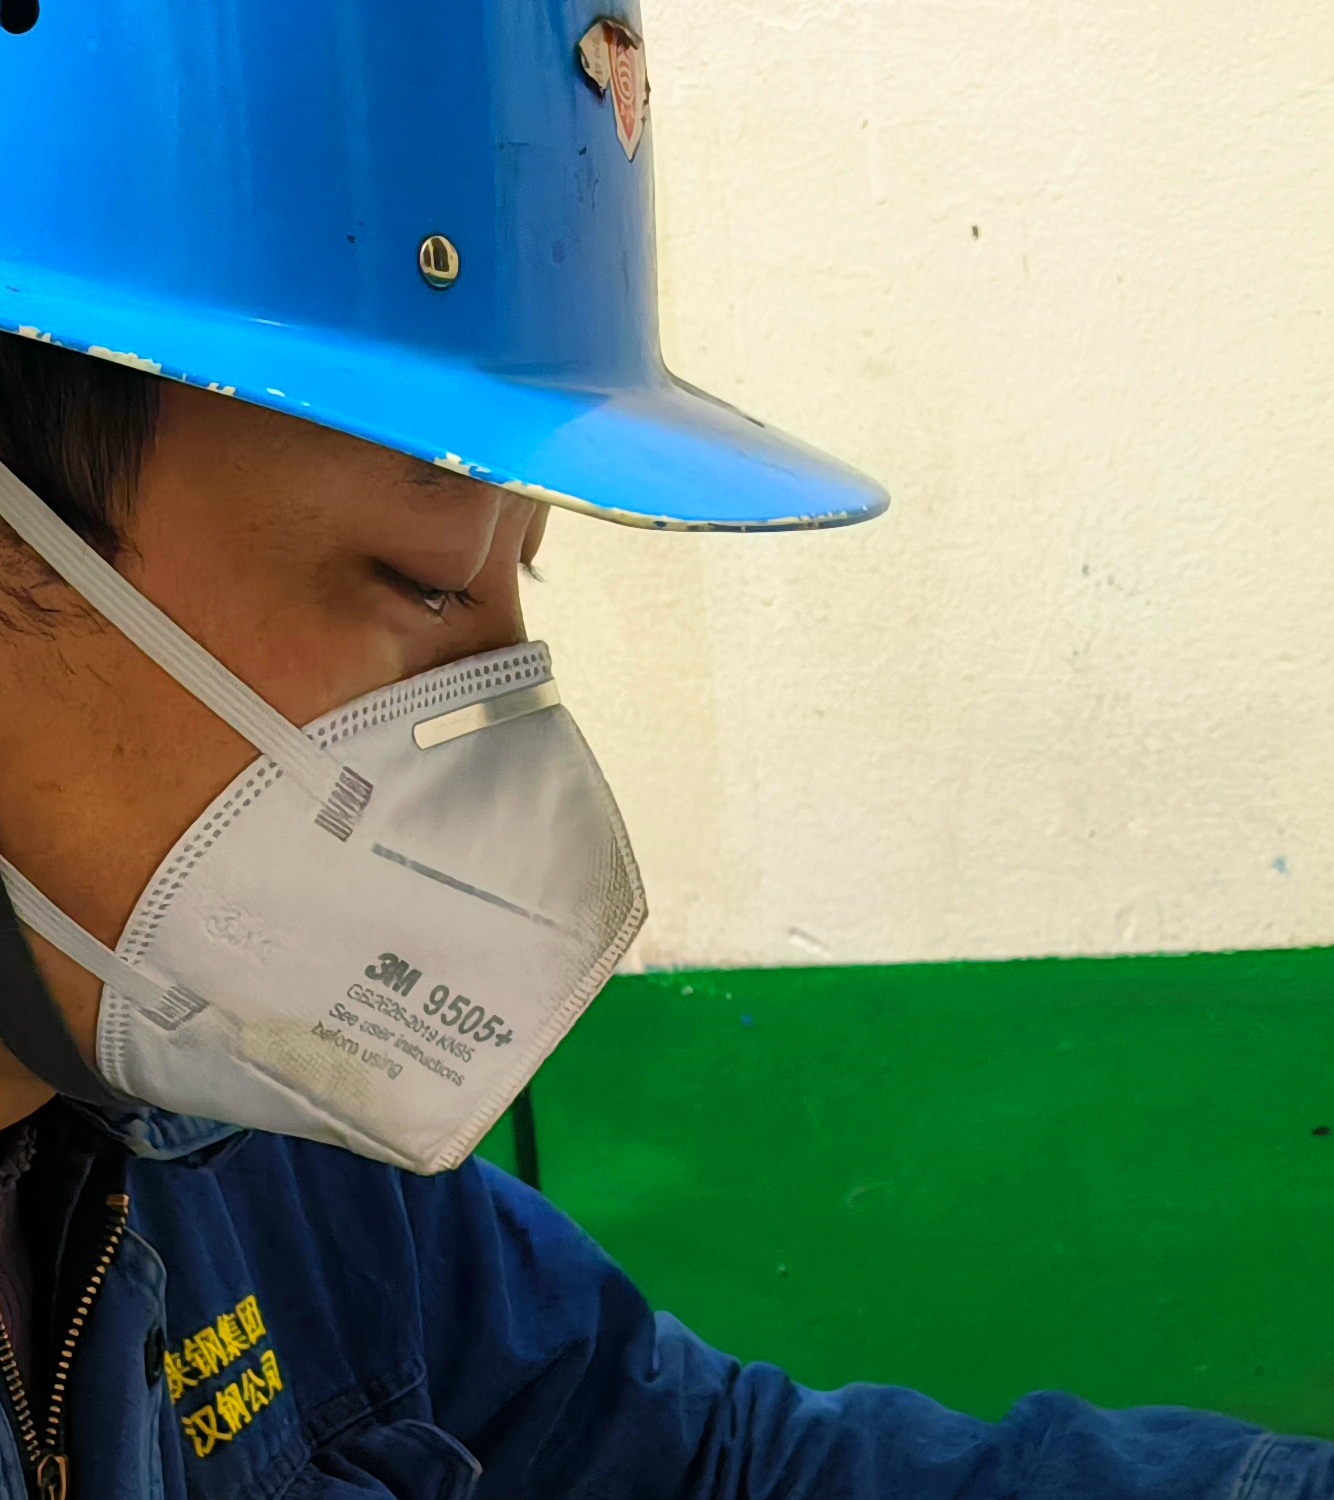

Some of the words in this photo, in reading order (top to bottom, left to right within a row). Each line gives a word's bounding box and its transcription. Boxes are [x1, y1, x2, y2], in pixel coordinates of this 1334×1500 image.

[328, 1002, 360, 1027] See
[393, 1033, 466, 1087] instructions
[365, 952, 423, 998] 3M
[422, 984, 514, 1048] 9505+
[360, 1048, 404, 1081] using
[180, 1349, 284, 1459] 汉钢公司
